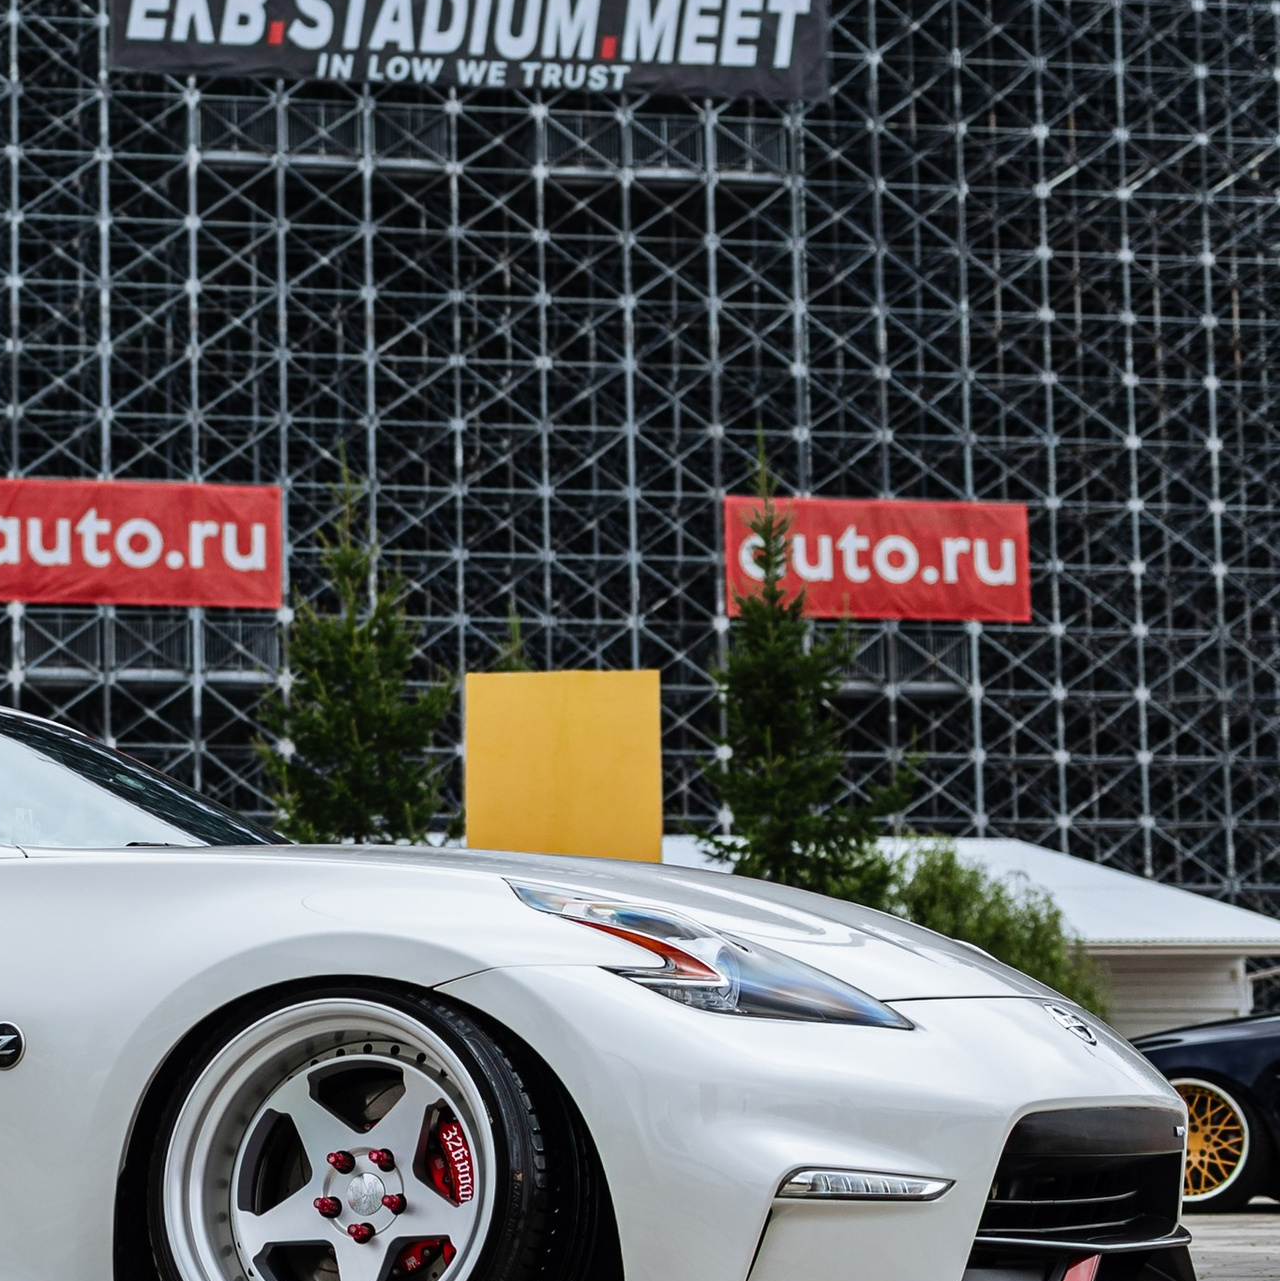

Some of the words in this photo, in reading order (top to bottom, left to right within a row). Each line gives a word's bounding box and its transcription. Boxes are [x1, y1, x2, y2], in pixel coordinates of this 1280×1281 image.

[316, 52, 355, 81] IN
[367, 54, 444, 85] LOW
[456, 58, 508, 88] WE
[521, 61, 631, 91] TRUST
